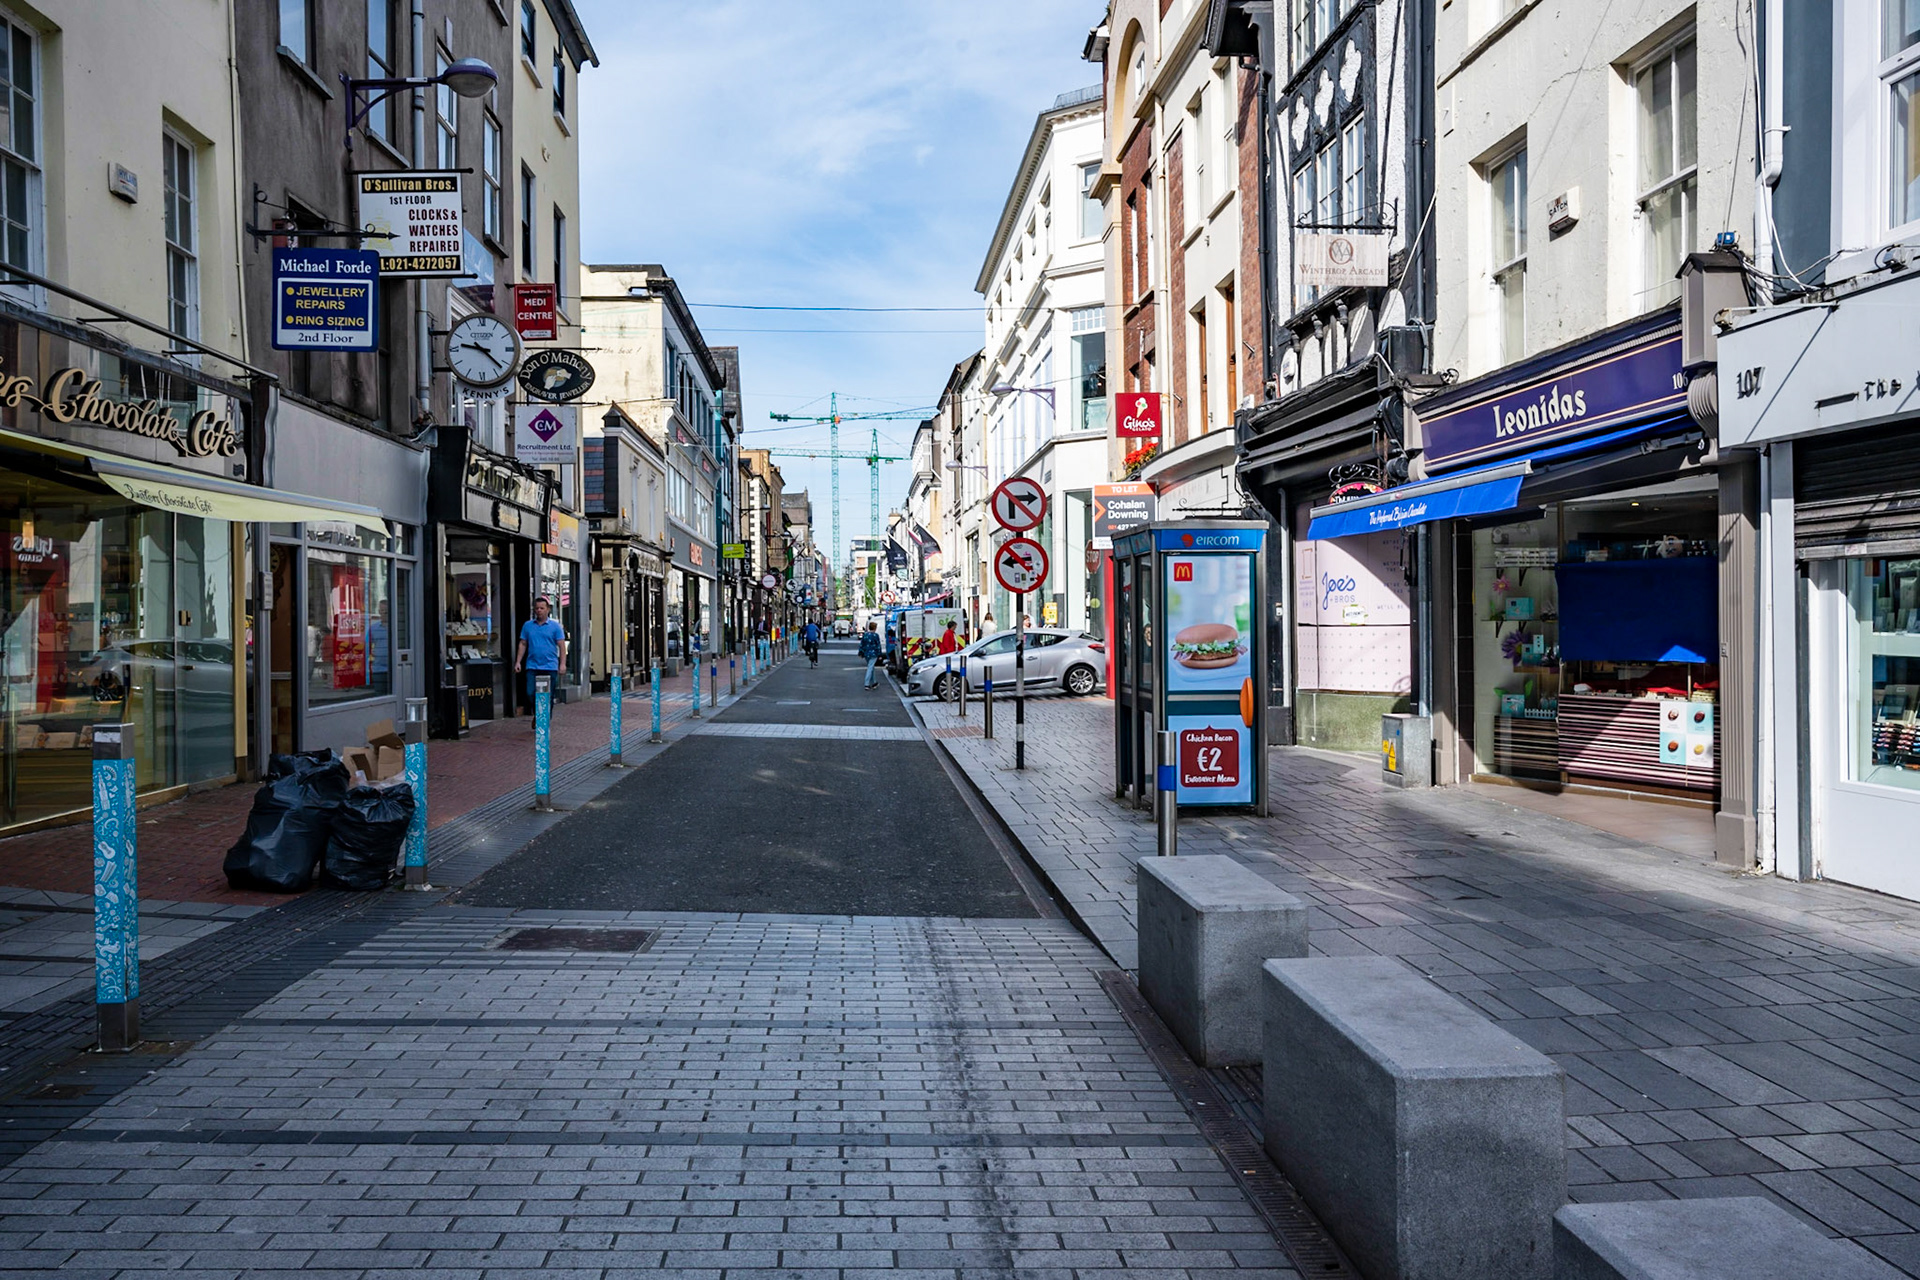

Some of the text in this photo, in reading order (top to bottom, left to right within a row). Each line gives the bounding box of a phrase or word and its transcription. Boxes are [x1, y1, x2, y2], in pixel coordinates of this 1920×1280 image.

[364, 179, 455, 191] O'Sullivan Bros.
[390, 195, 432, 205] 1st FLOOR
[409, 209, 458, 221] CLOCKS &
[409, 225, 459, 237] WATCHES
[409, 241, 459, 253] REPAIRED
[280, 259, 372, 274] Michael Forde
[380, 257, 457, 271] L:021-4272057
[296, 286, 366, 298] JEWELLERY
[295, 299, 346, 311] REPAIRS
[524, 298, 547, 306] MEDI
[295, 315, 365, 327] RING SIZING
[517, 312, 553, 320] CENTRE
[298, 332, 354, 343] 2nd Floor
[520, 352, 592, 380] Don O'Mahony
[1672, 370, 1689, 390] 106
[1737, 366, 1766, 400] 107
[462, 386, 510, 399] KENNY'S
[524, 381, 591, 400] ENGRAVER JEWELLER
[50, 368, 180, 442] Chocolate
[190, 409, 237, 457] Café
[1492, 384, 1587, 438] Leonidas
[1123, 415, 1155, 429] Gino's
[1123, 485, 1138, 493] LET
[1107, 500, 1146, 510] Cohalan
[1107, 510, 1149, 520] Downing
[1086, 550, 1100, 563] STOP
[1322, 571, 1356, 611] Joe's
[468, 687, 492, 699] nny's
[1186, 733, 1233, 743] Chicken Bacon
[1197, 747, 1223, 772] €2
[1217, 774, 1236, 783] Menu
